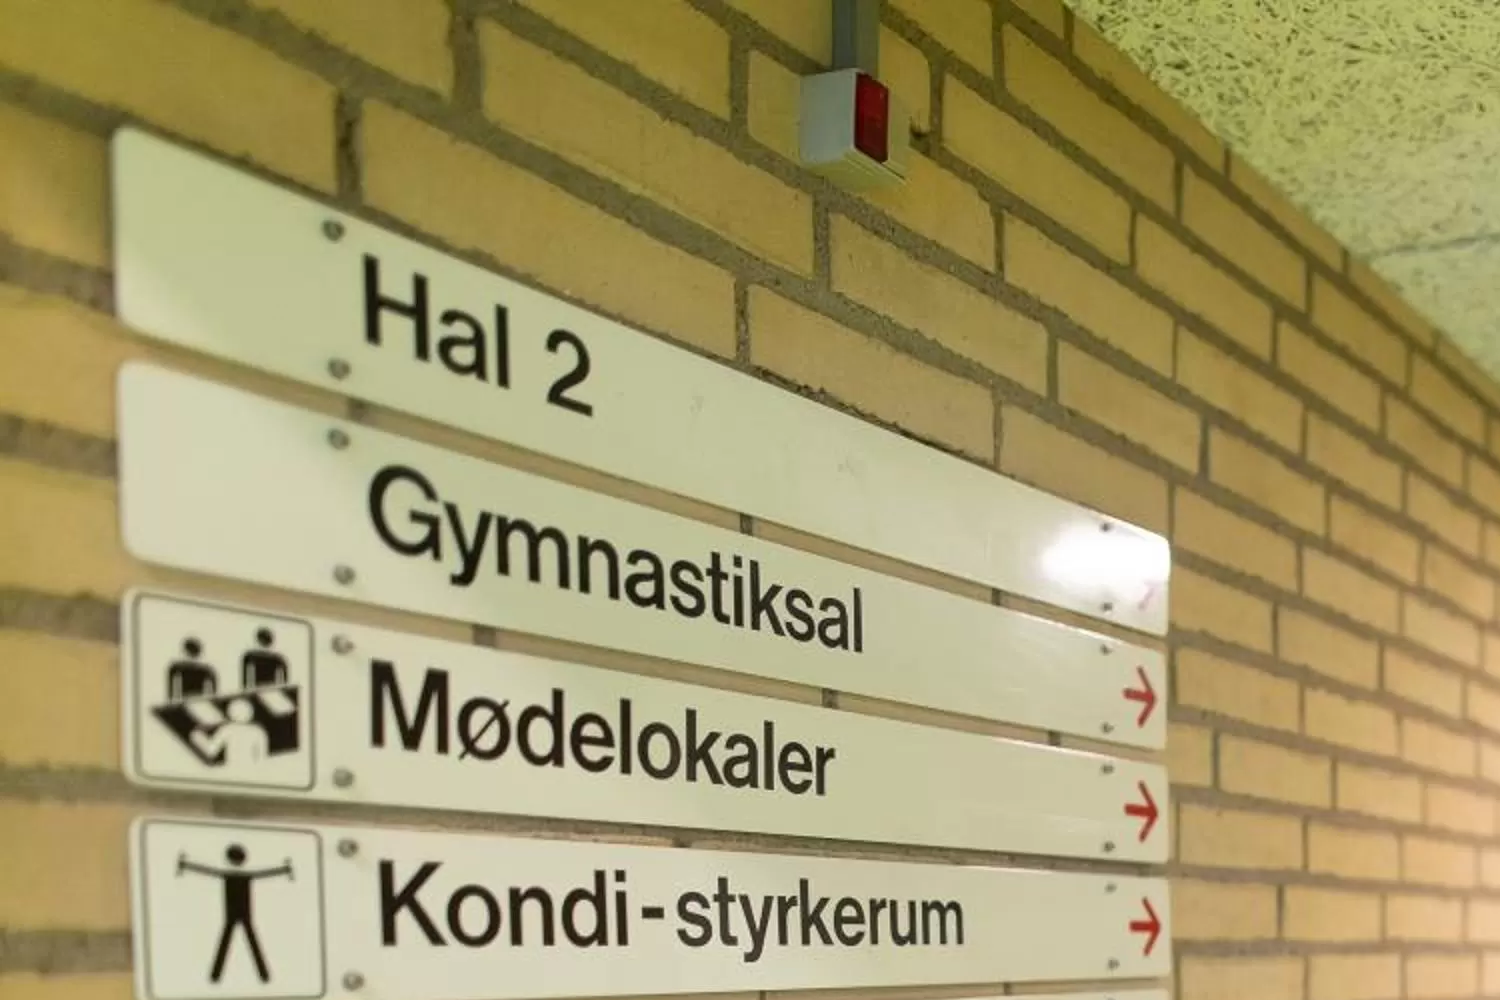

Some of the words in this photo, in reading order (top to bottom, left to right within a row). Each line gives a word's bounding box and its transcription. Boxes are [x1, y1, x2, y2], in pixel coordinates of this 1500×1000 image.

[362, 252, 510, 391] Hal
[544, 328, 594, 418] 2
[368, 463, 864, 655] Gymnastiksal
[370, 658, 837, 797] Mødelokaler
[378, 858, 965, 963] Kondi-styrkerum
